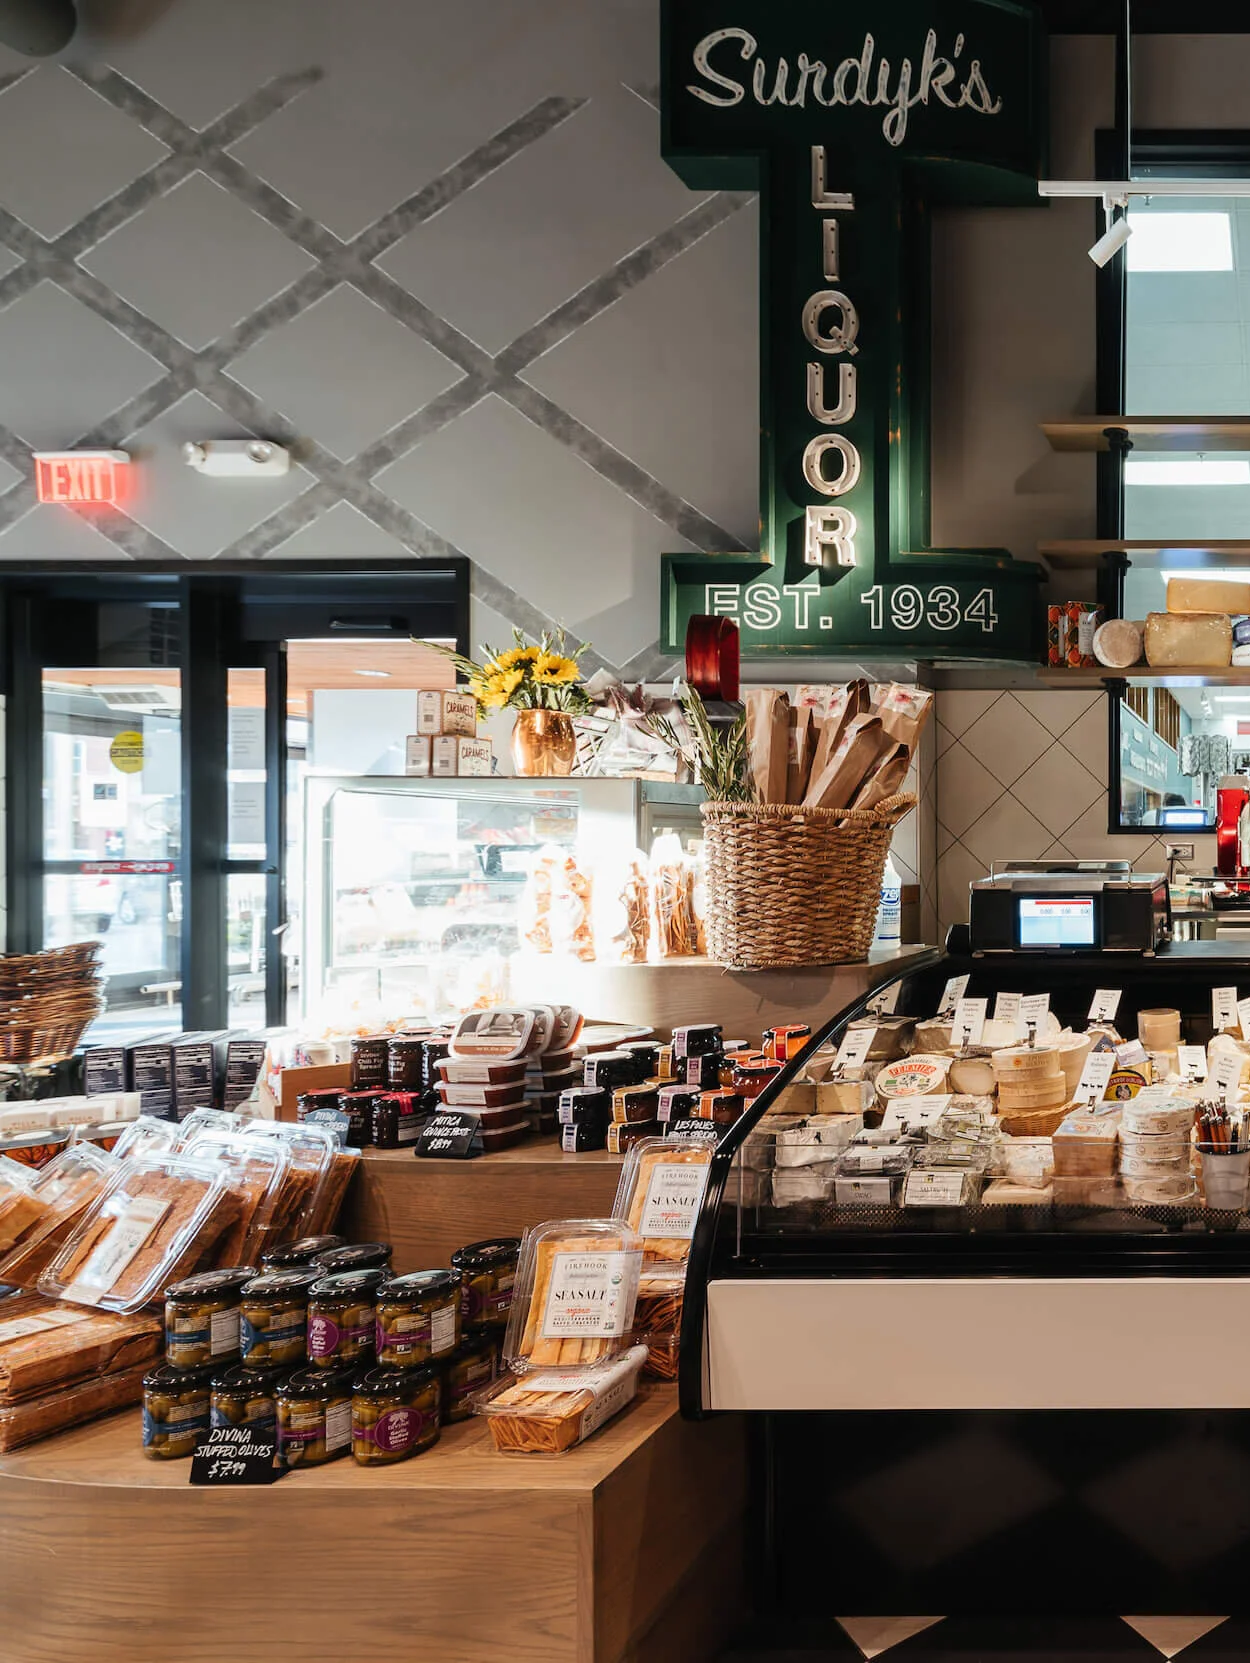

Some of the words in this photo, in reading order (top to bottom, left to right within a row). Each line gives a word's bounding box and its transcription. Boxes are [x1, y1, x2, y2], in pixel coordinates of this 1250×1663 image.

[686, 27, 1002, 147] Surdyk's
[801, 145, 861, 567] LIQUOR
[51, 460, 104, 500] EXIT
[704, 584, 834, 631] EST.
[861, 584, 999, 632] 1934
[446, 701, 474, 718] CARAMELS
[461, 745, 489, 761] CARAMELS
[431, 1116, 462, 1126] MITICA
[674, 1120, 690, 1130] LES
[651, 1196, 670, 1206] SEA
[671, 1196, 698, 1206] SALT
[564, 1263, 608, 1271] FIREHOOK
[555, 1289, 575, 1301] SEA
[577, 1289, 608, 1301] SALT
[208, 1428, 252, 1443] DIVINA
[193, 1445, 238, 1458] STUFFED
[238, 1445, 275, 1458] OLIVES
[207, 1460, 247, 1478] $7.99
